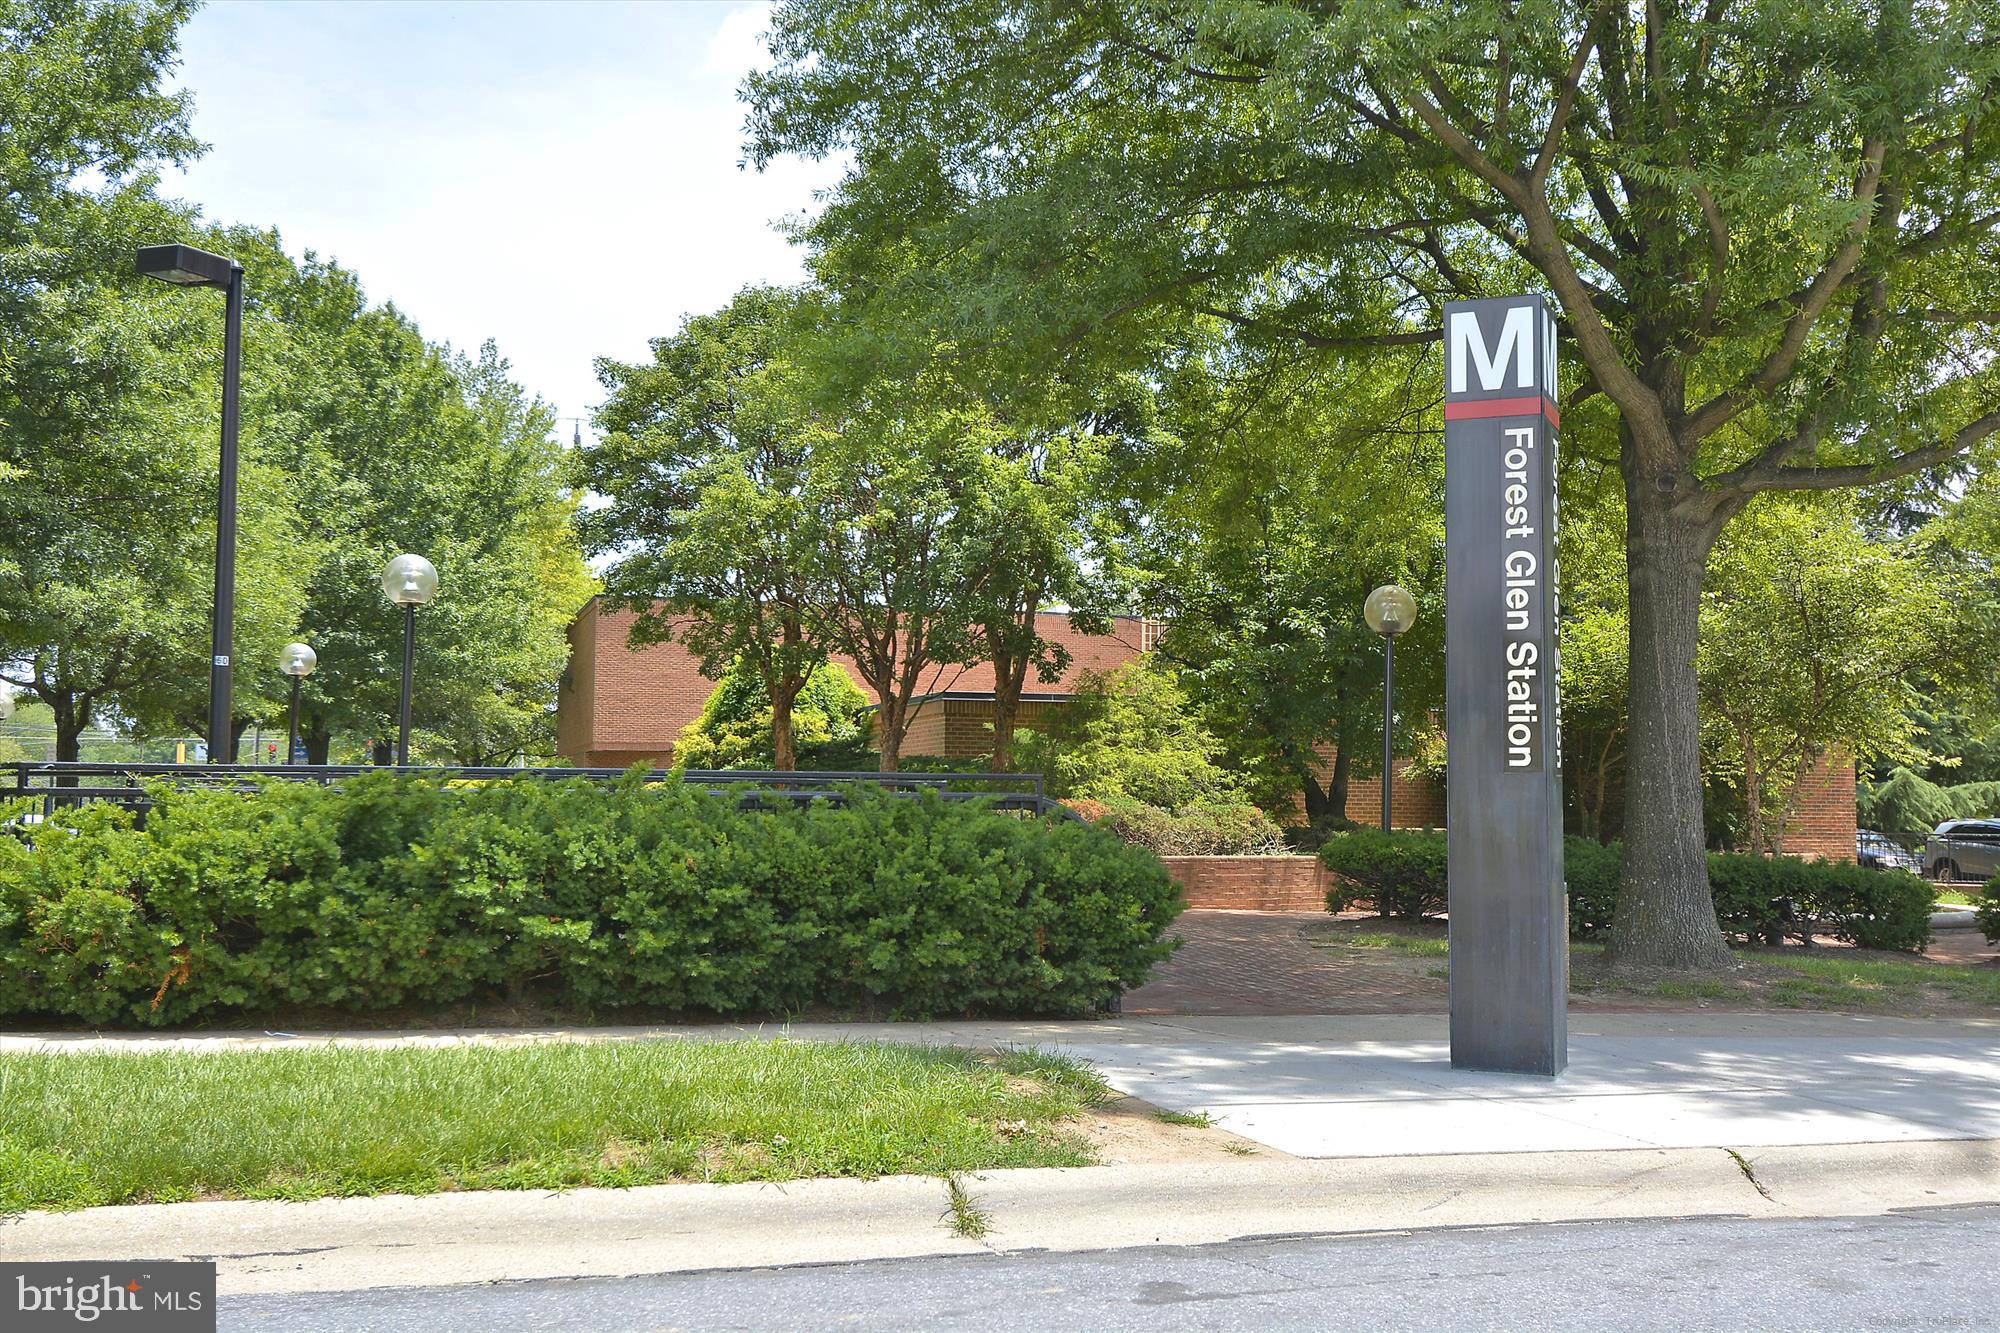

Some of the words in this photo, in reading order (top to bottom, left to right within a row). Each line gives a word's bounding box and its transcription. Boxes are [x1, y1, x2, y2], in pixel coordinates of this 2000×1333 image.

[1450, 306, 1535, 393] M
[1542, 307, 1558, 404] M
[1504, 427, 1535, 539] Forest
[1552, 437, 1560, 547] Forest
[1504, 550, 1537, 631] Glen
[1553, 558, 1561, 636] Glen
[1506, 641, 1538, 768] Station
[1554, 647, 1562, 769] Station
